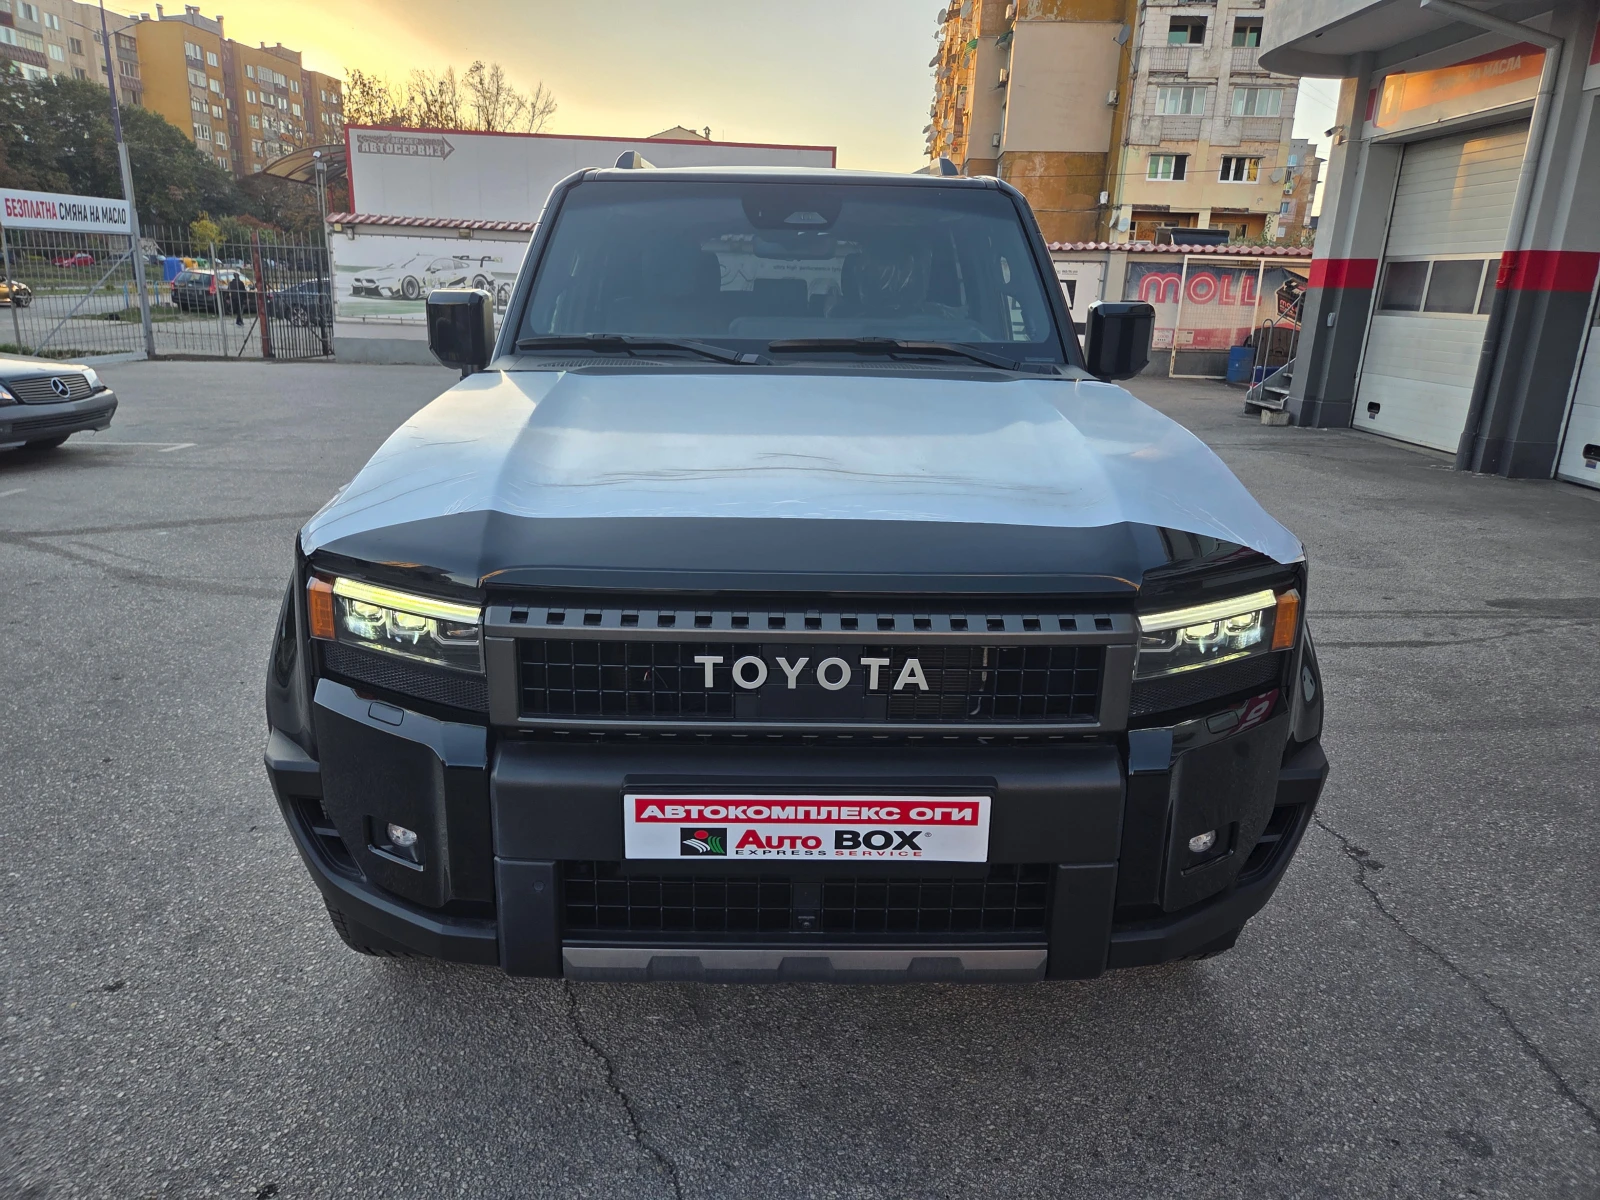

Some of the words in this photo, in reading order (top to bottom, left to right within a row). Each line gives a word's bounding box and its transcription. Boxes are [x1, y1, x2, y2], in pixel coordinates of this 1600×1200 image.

[1483, 55, 1522, 78] МАСЛА
[1385, 84, 1395, 114] 1
[361, 141, 442, 156] АВТОСЕРВИЗ
[4, 197, 58, 220] БЕЗПЛАТНА
[59, 202, 88, 222] СМЯНА
[89, 205, 101, 223] НА
[102, 206, 127, 225] МАСЛО
[694, 655, 930, 691] TOYOTA
[640, 804, 901, 820] АВТОКОМПЛЕКС
[909, 807, 973, 821] ОГИ
[835, 830, 923, 851] BOX
